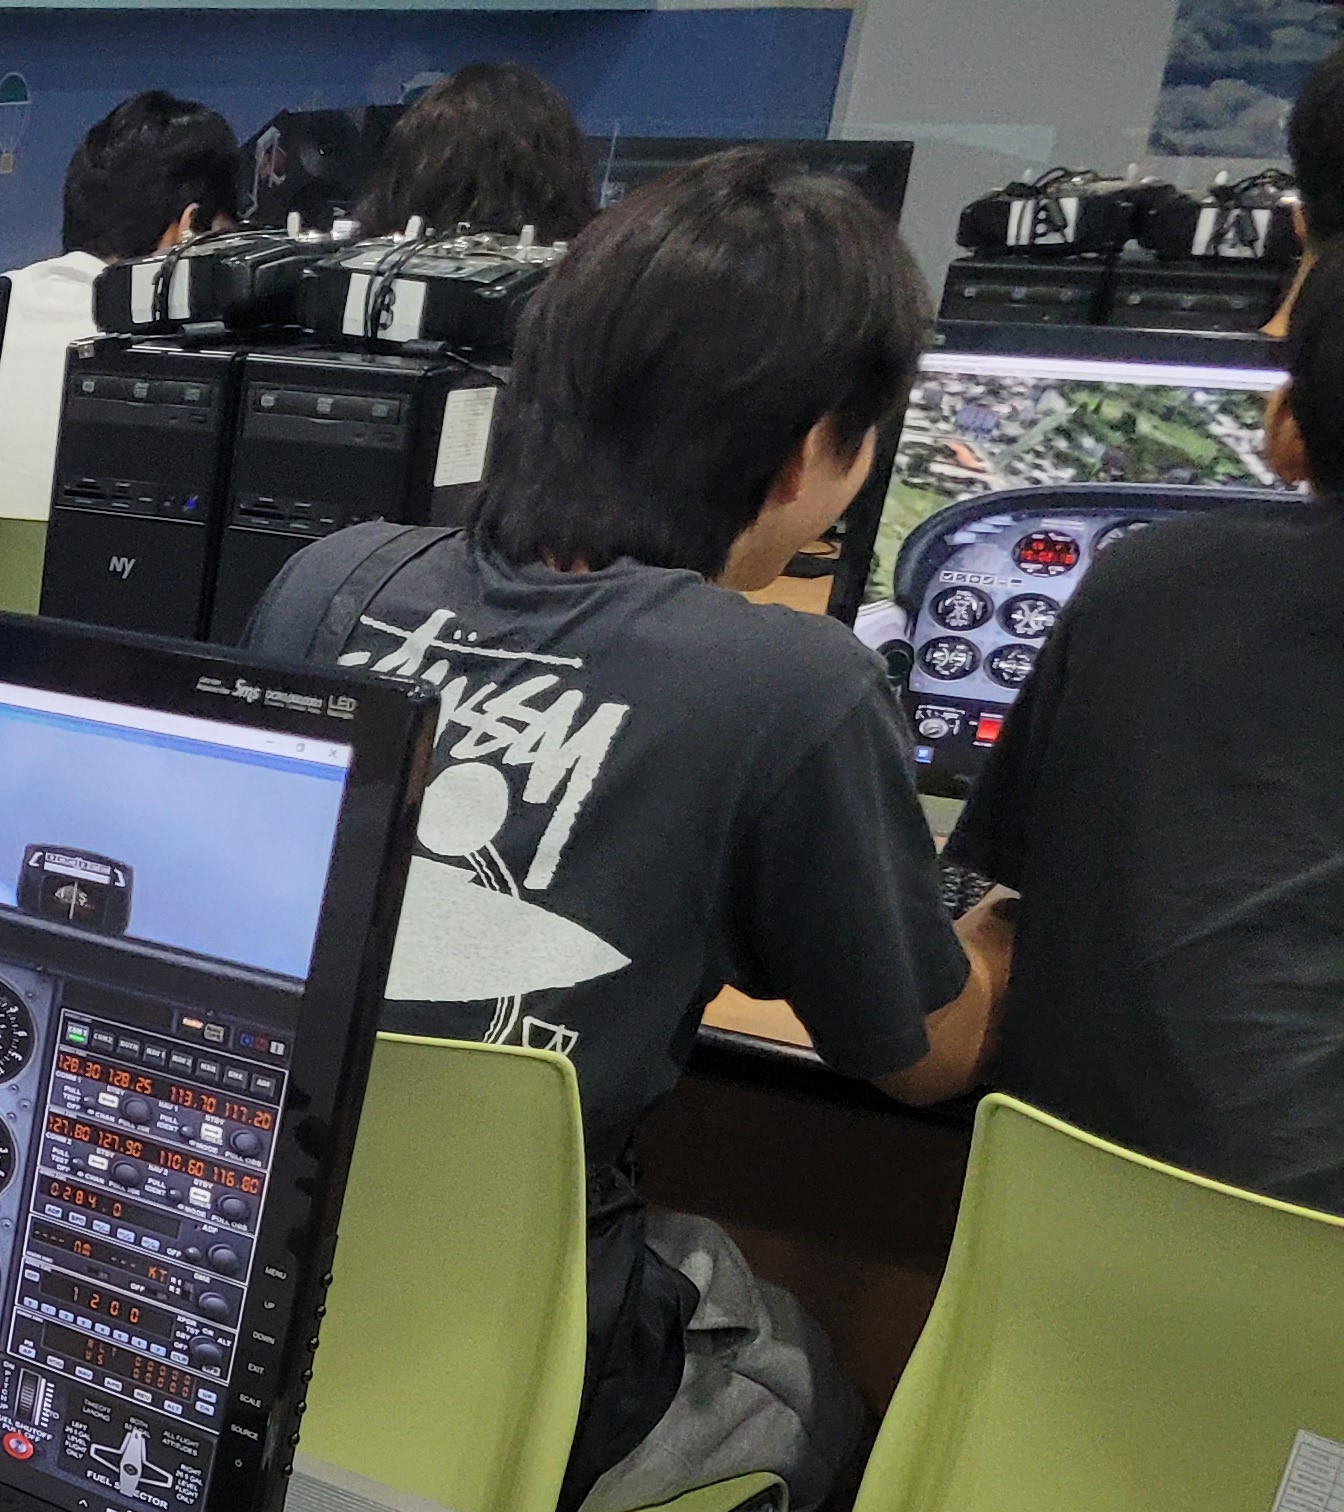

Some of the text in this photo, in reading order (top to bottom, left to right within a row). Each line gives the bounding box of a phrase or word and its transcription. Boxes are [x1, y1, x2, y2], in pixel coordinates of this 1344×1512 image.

[265, 1265, 288, 1280] MENU
[252, 1330, 276, 1345] DOWN
[247, 1362, 266, 1375] EXIT
[239, 1393, 263, 1409] SCALE
[229, 1423, 260, 1442] SOURCE
[86, 1470, 169, 1510] FUEL SECTOR
